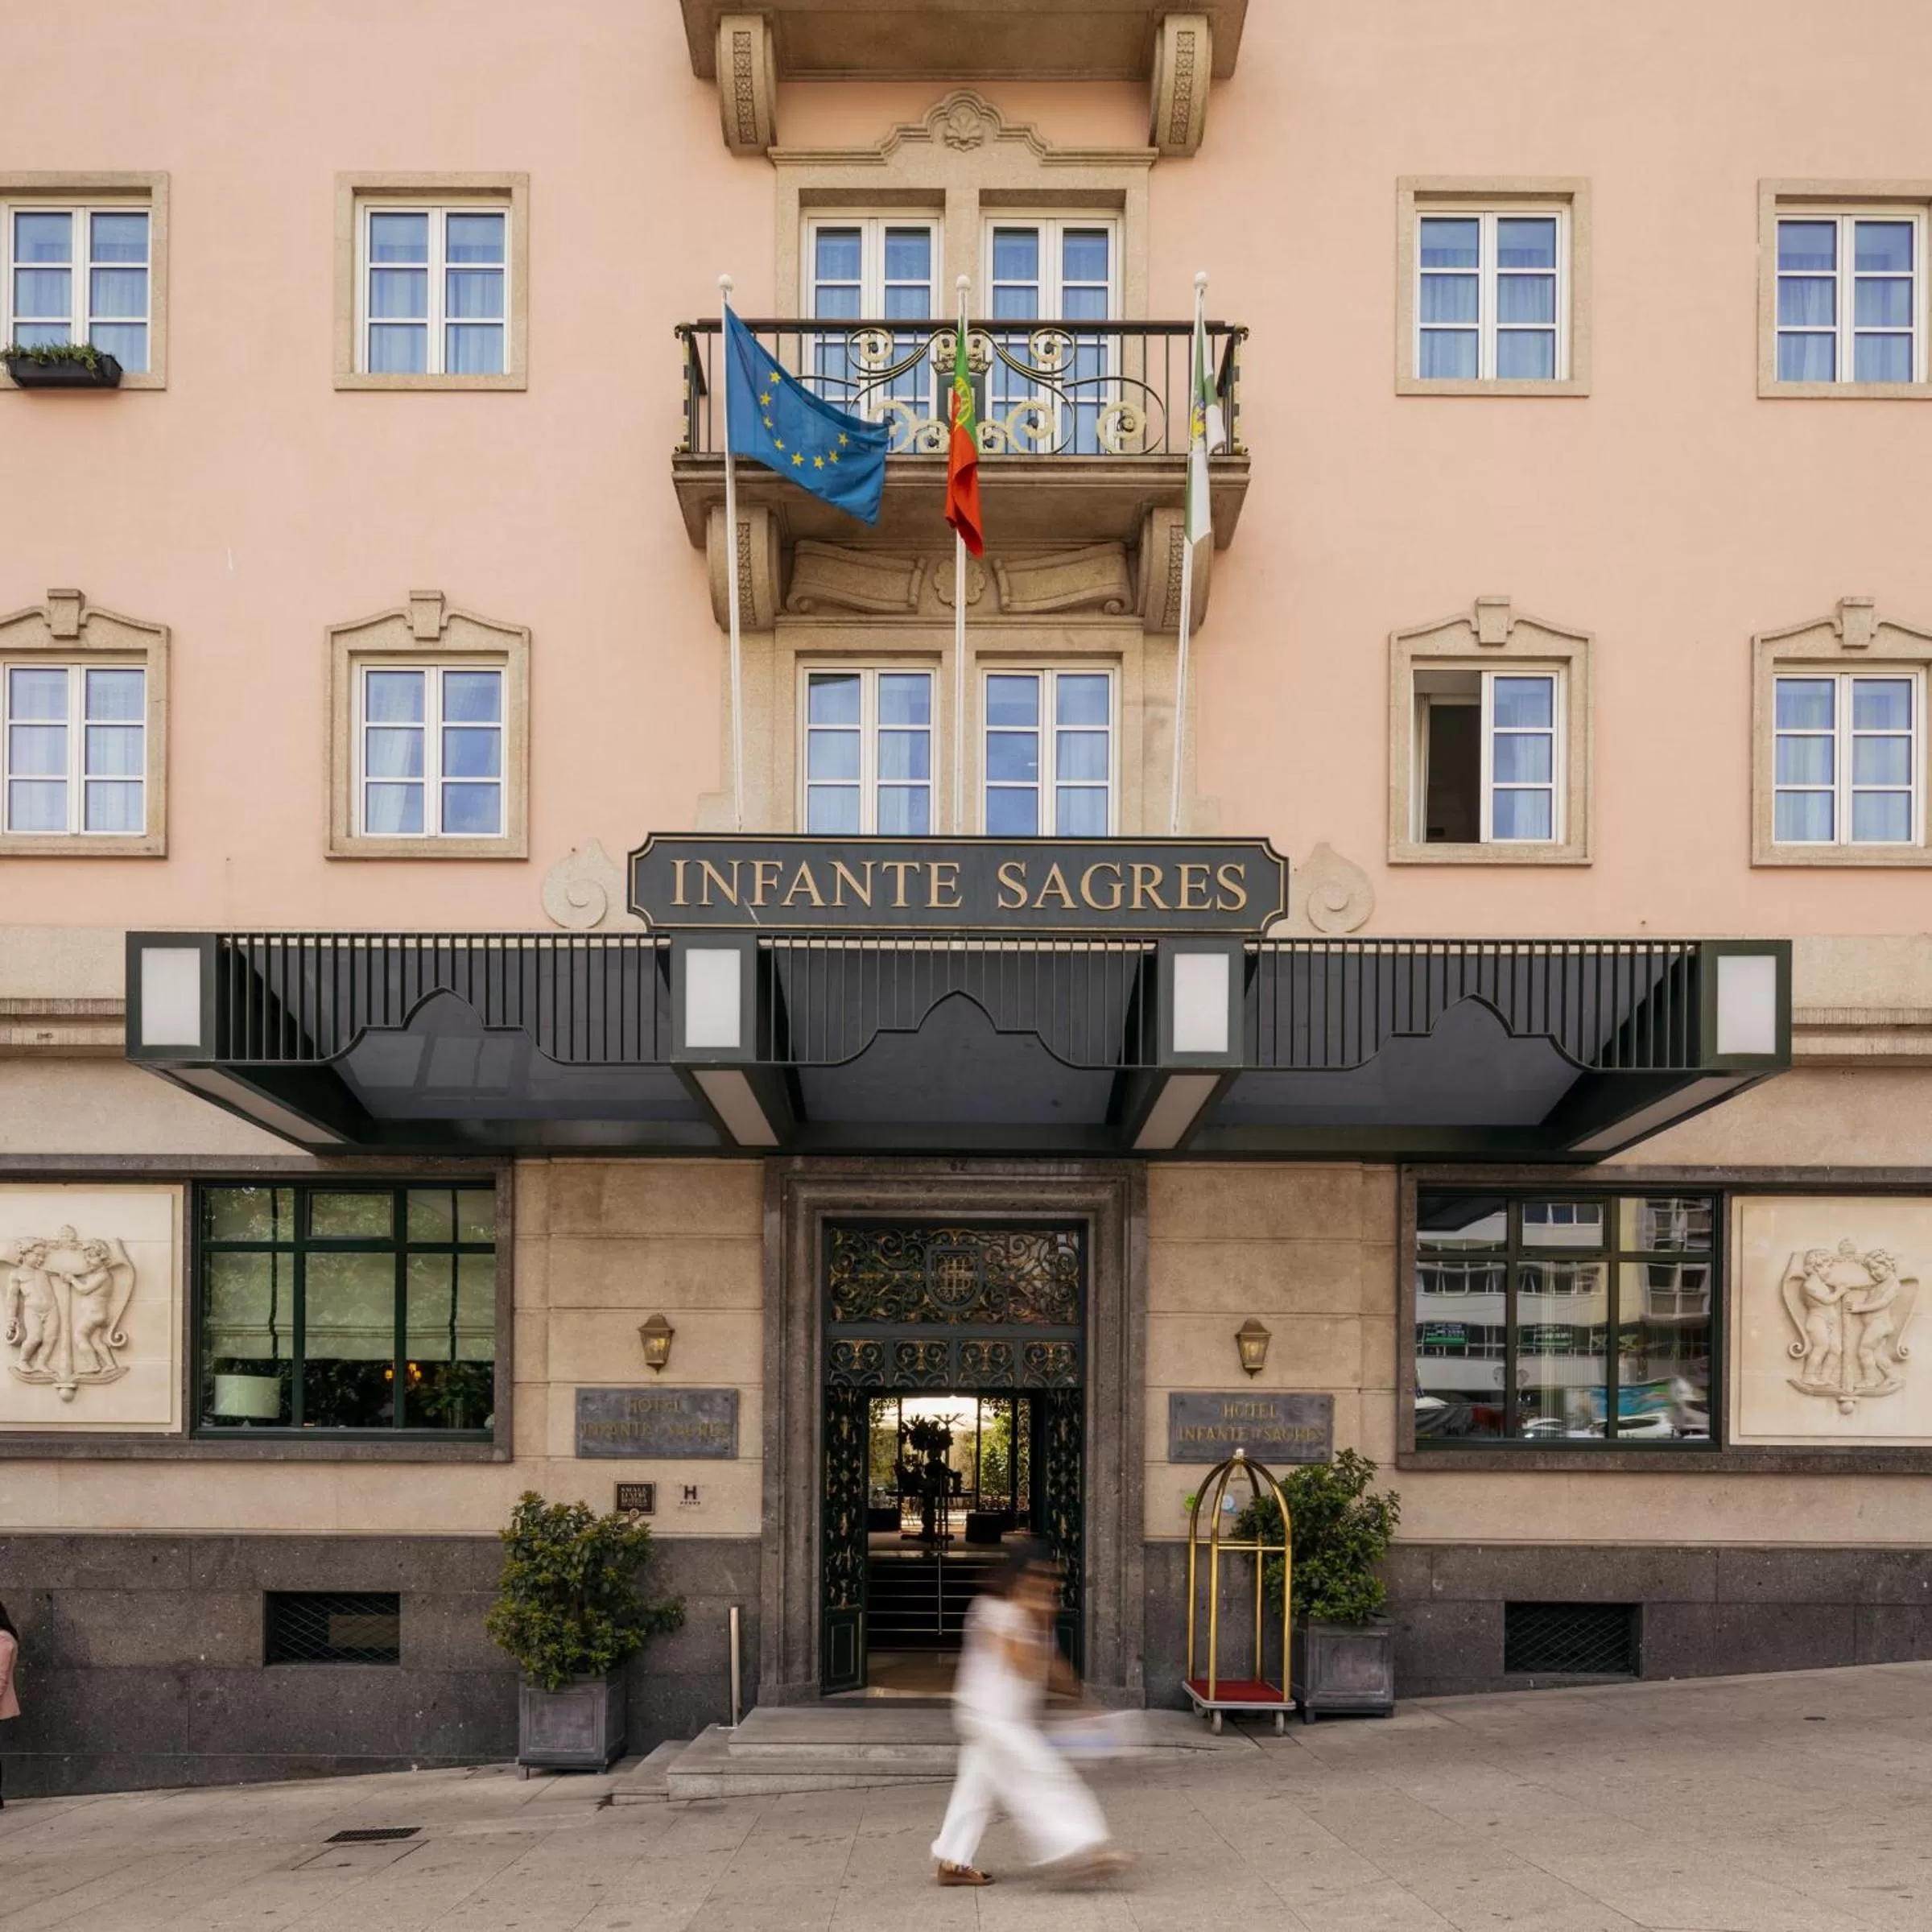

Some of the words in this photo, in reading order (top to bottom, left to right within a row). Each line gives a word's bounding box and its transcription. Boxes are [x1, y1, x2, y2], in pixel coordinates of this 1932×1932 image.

[670, 860, 963, 908] INFANTE
[997, 861, 1248, 910] SAGRES
[1223, 1402, 1276, 1418] HOTEL
[1179, 1426, 1247, 1442] INFANTE
[683, 1484, 698, 1500] H
